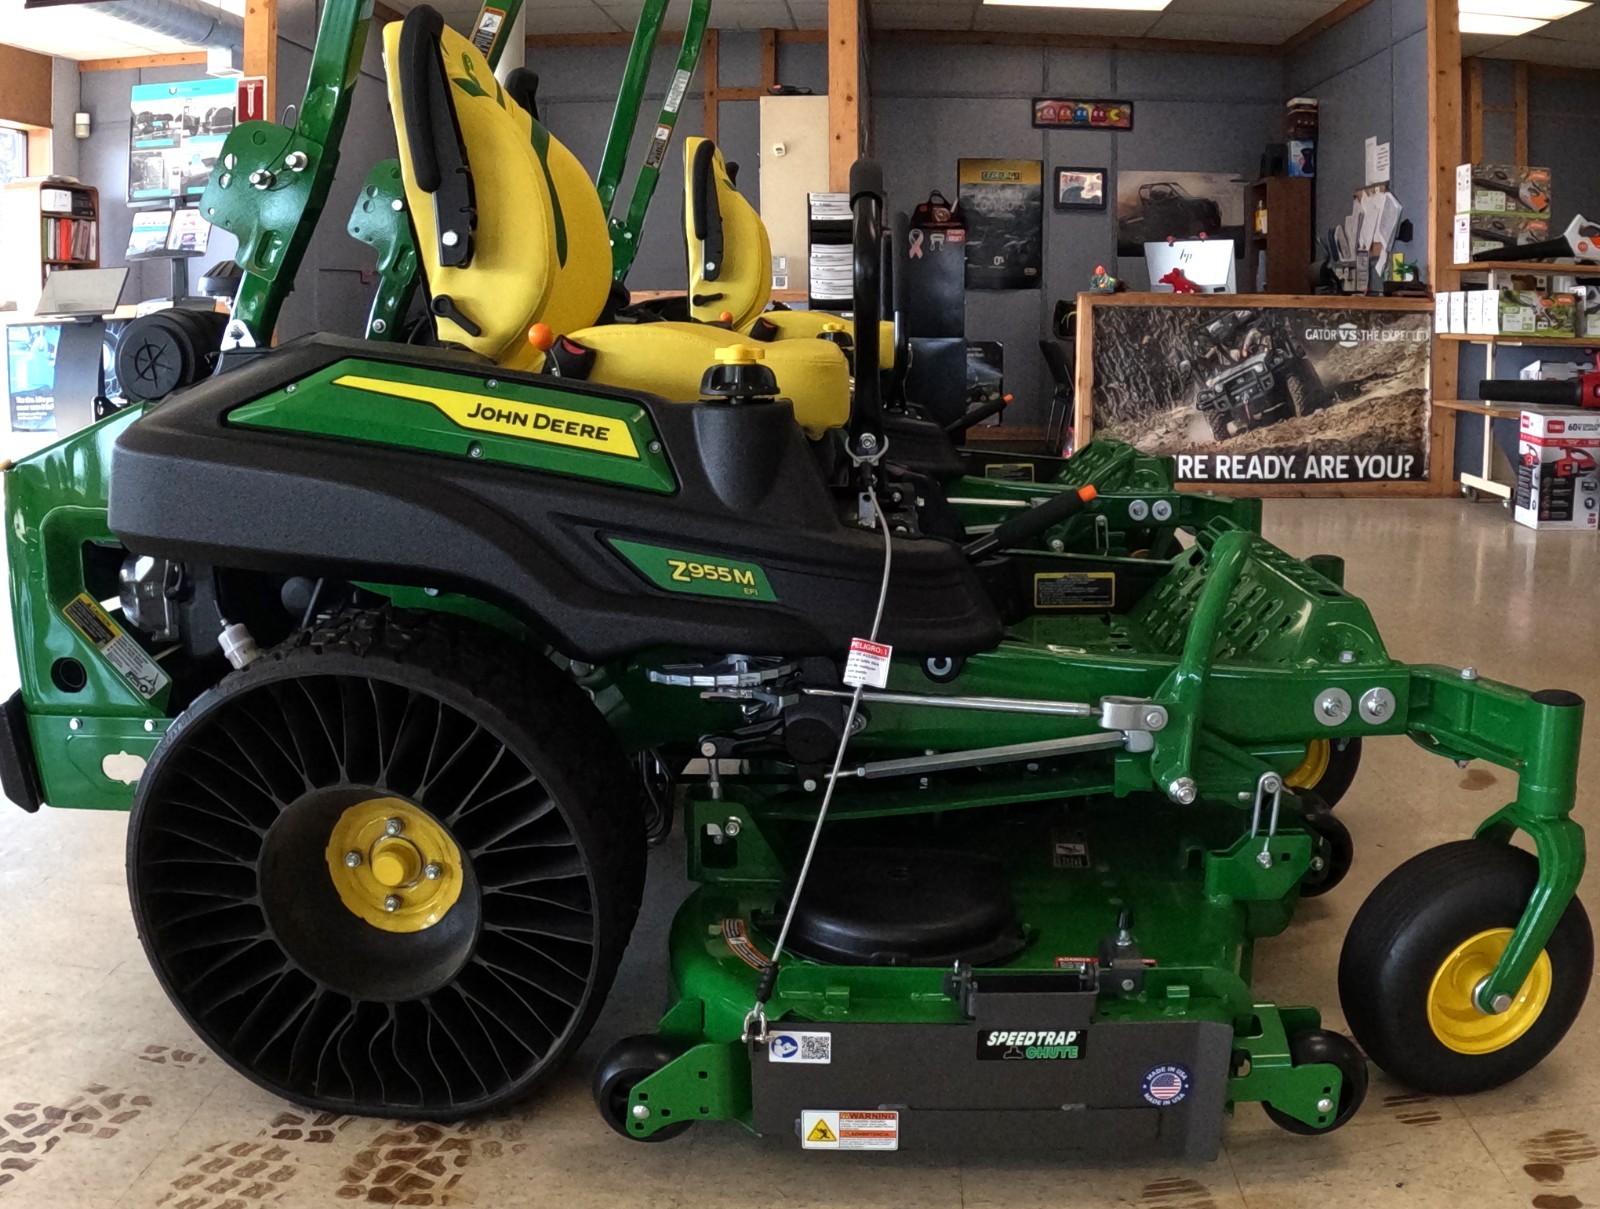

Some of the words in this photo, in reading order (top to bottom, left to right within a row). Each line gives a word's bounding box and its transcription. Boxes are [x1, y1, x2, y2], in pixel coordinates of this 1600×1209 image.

[1305, 329, 1337, 340] GATOR
[1361, 330, 1379, 340] THE
[467, 403, 528, 427] JOHN
[532, 413, 610, 441] DEERE
[1215, 454, 1296, 479] READY.
[1303, 454, 1350, 479] ARE
[1354, 454, 1414, 479] YOU?
[986, 1031, 1077, 1046] SPEEDTRAP
[1026, 1046, 1078, 1059] CHUTE
[1146, 1067, 1165, 1080] MADE
[1176, 1068, 1188, 1080] USA
[1144, 1093, 1161, 1105] MADE
[1172, 1093, 1185, 1104] USA
